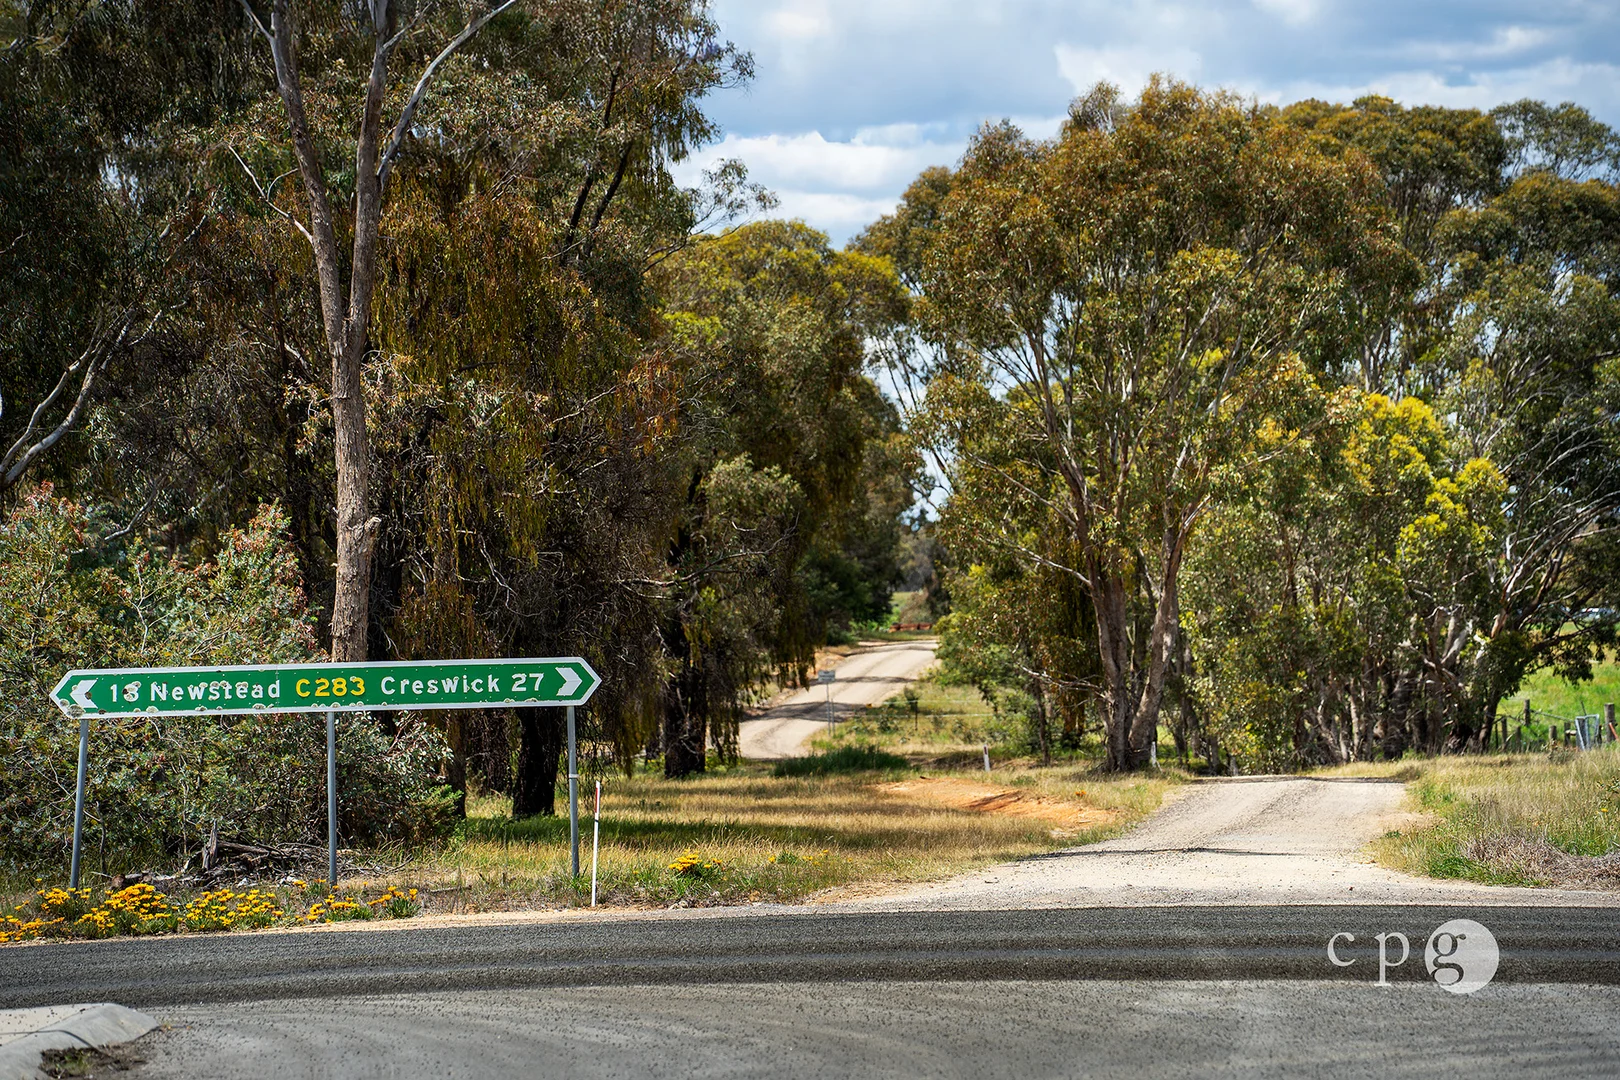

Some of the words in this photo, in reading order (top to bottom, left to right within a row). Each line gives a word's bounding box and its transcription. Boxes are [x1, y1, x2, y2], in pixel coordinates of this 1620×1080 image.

[150, 680, 281, 702] Newstead
[295, 677, 366, 698] C283
[380, 674, 501, 696] Creswick
[511, 673, 545, 692] 27
